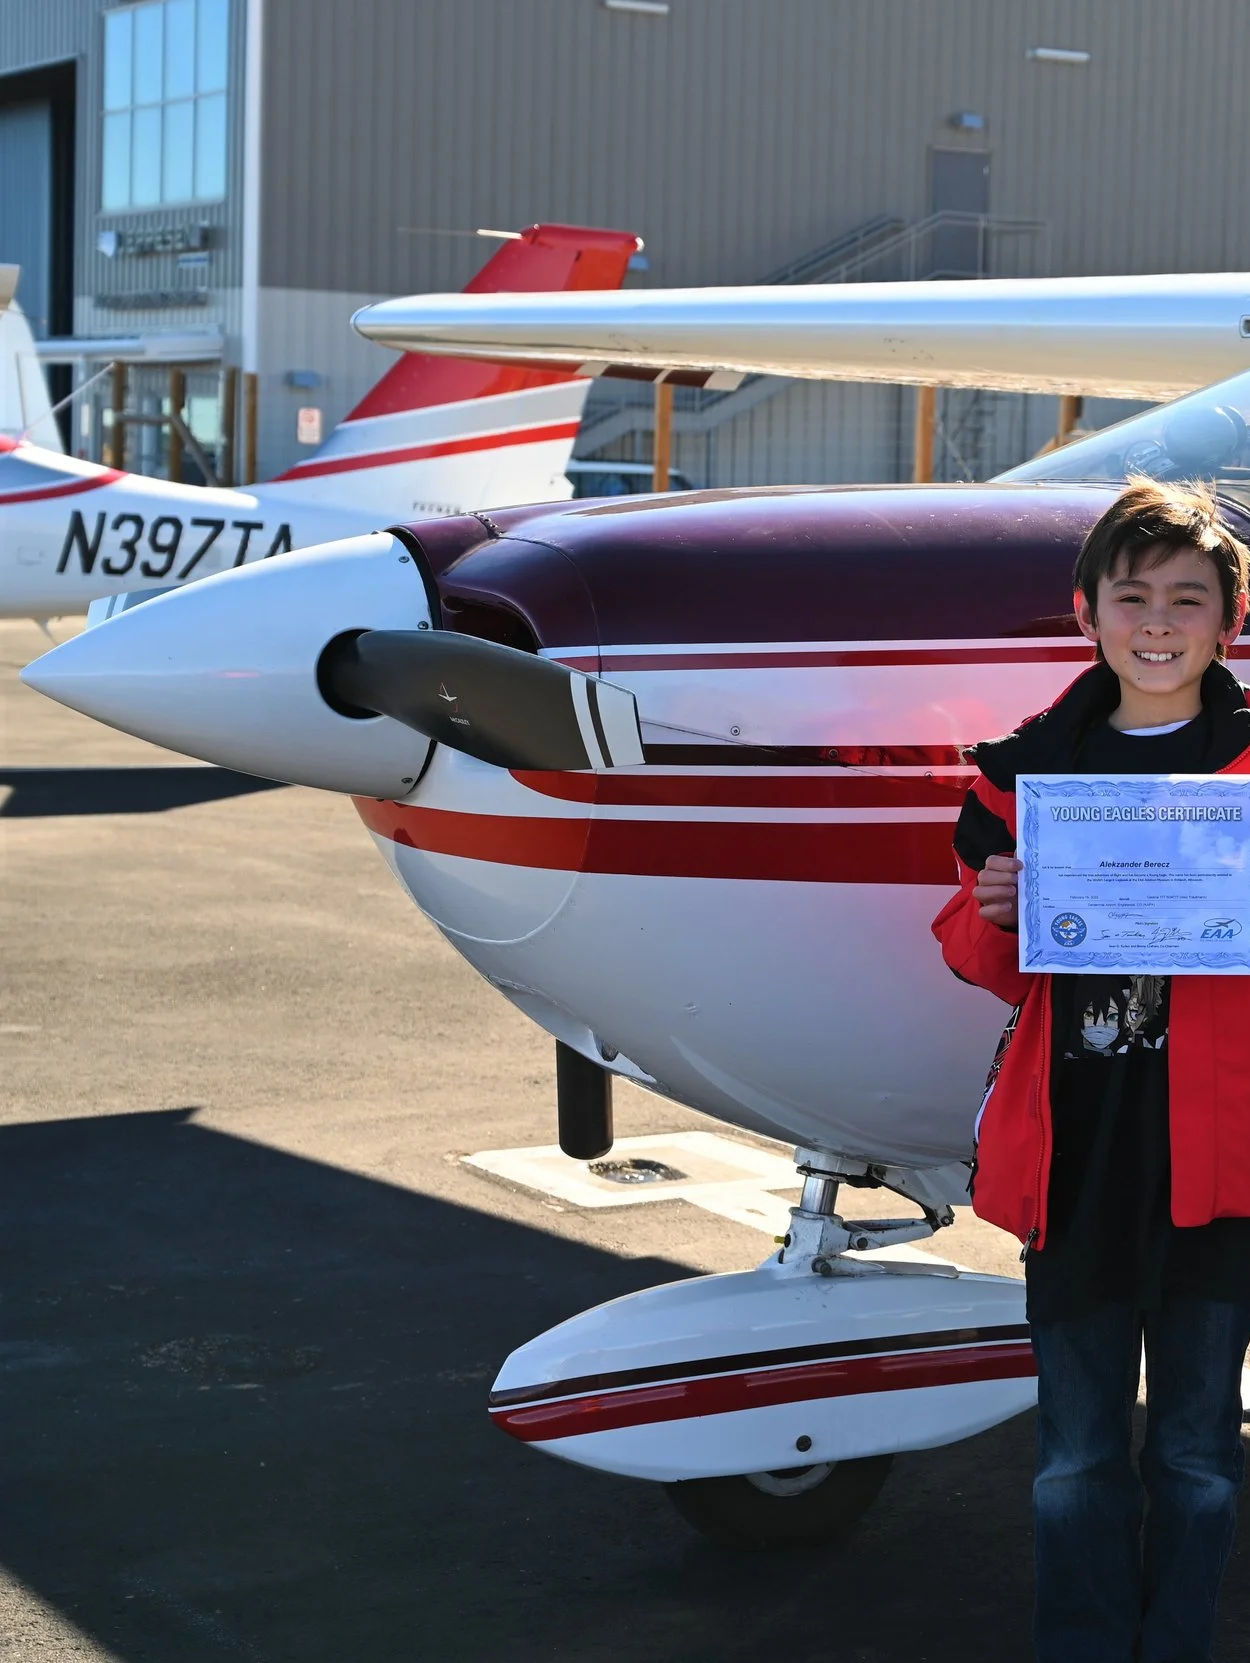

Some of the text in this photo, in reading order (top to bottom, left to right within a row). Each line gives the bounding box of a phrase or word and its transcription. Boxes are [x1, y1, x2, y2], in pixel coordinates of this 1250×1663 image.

[1050, 806, 1242, 821] YOUNG EAGLES CERTIFICATE
[1099, 860, 1170, 868] Alekzander Berecz
[1200, 928, 1233, 939] EAA
